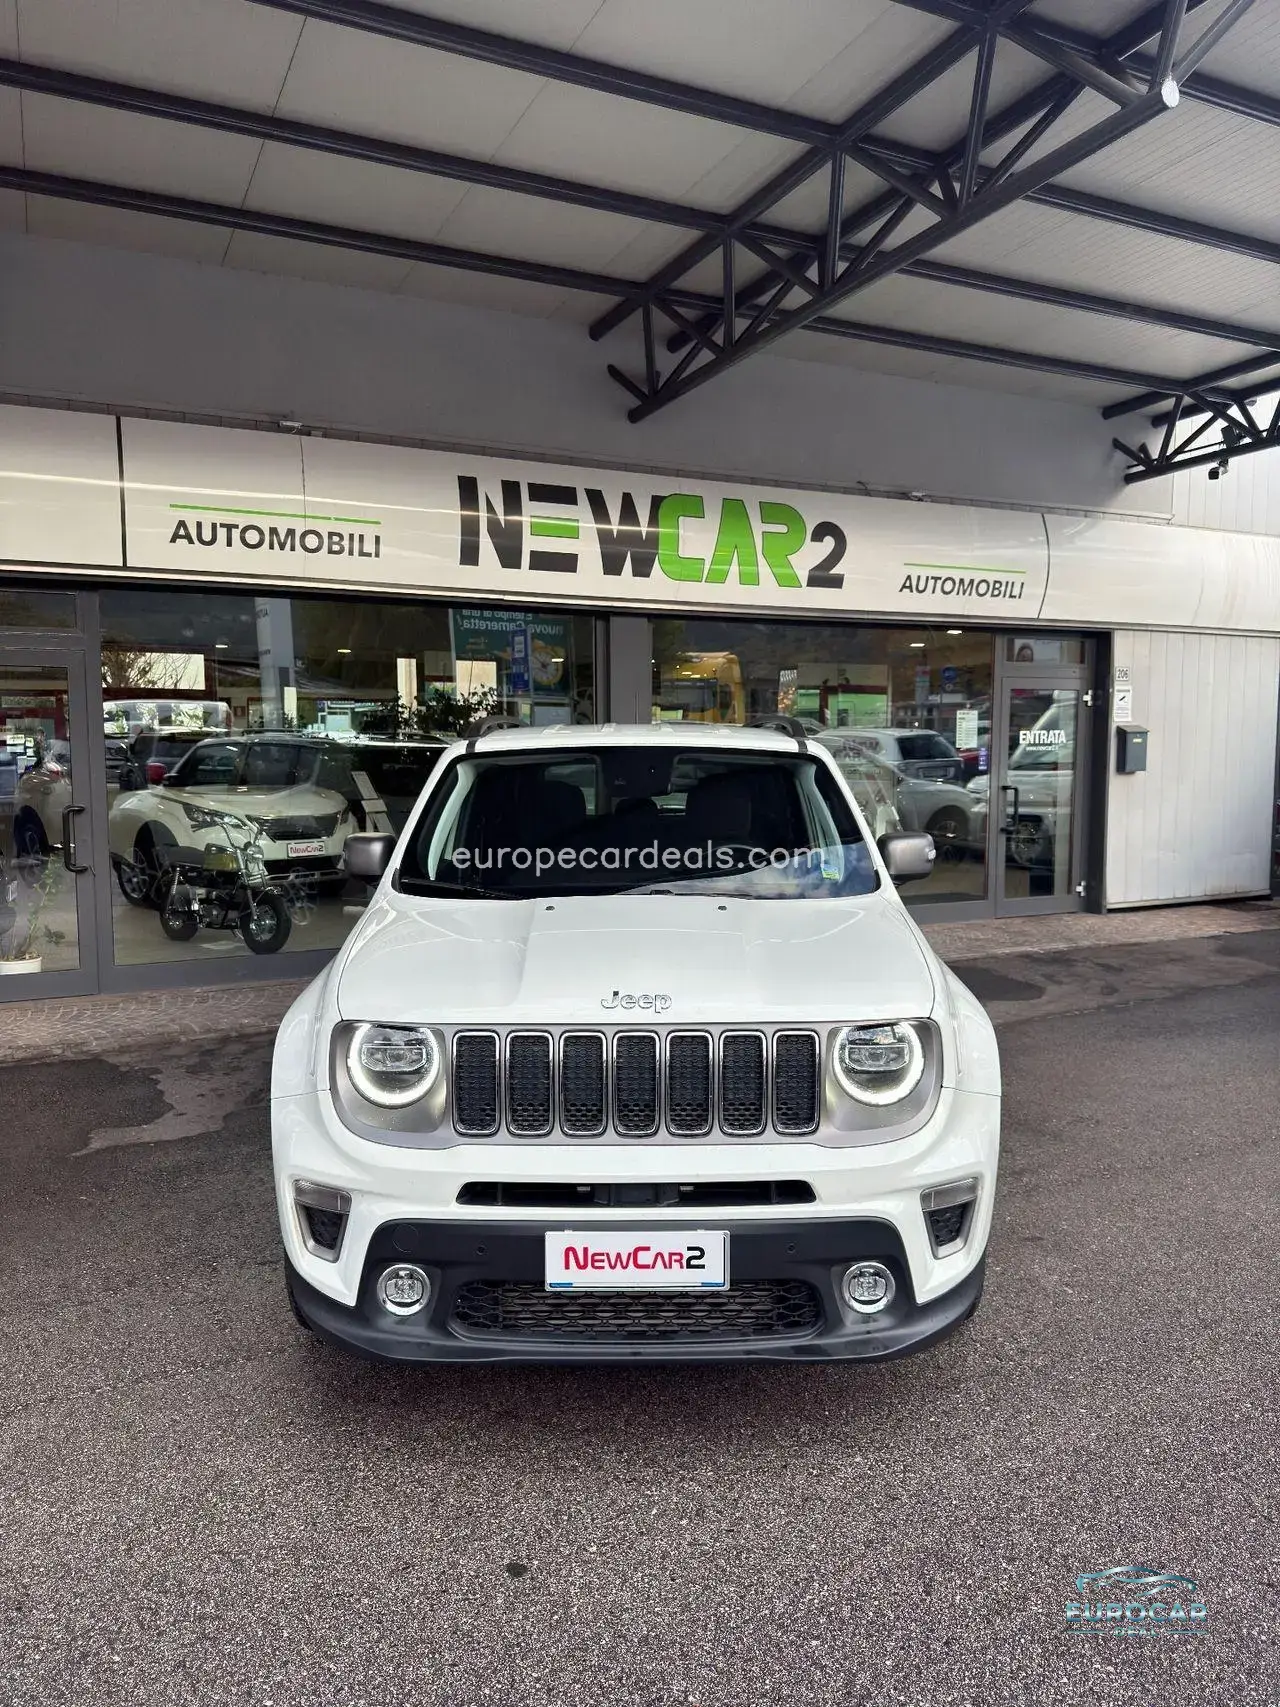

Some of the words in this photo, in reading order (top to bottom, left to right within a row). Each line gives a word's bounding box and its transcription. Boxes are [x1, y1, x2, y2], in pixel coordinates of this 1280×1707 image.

[169, 519, 382, 559] AUTOMOBILI
[899, 574, 1025, 599] AUTOMOBILI
[1019, 729, 1066, 744] ENTRATA
[600, 990, 672, 1014] Jeep
